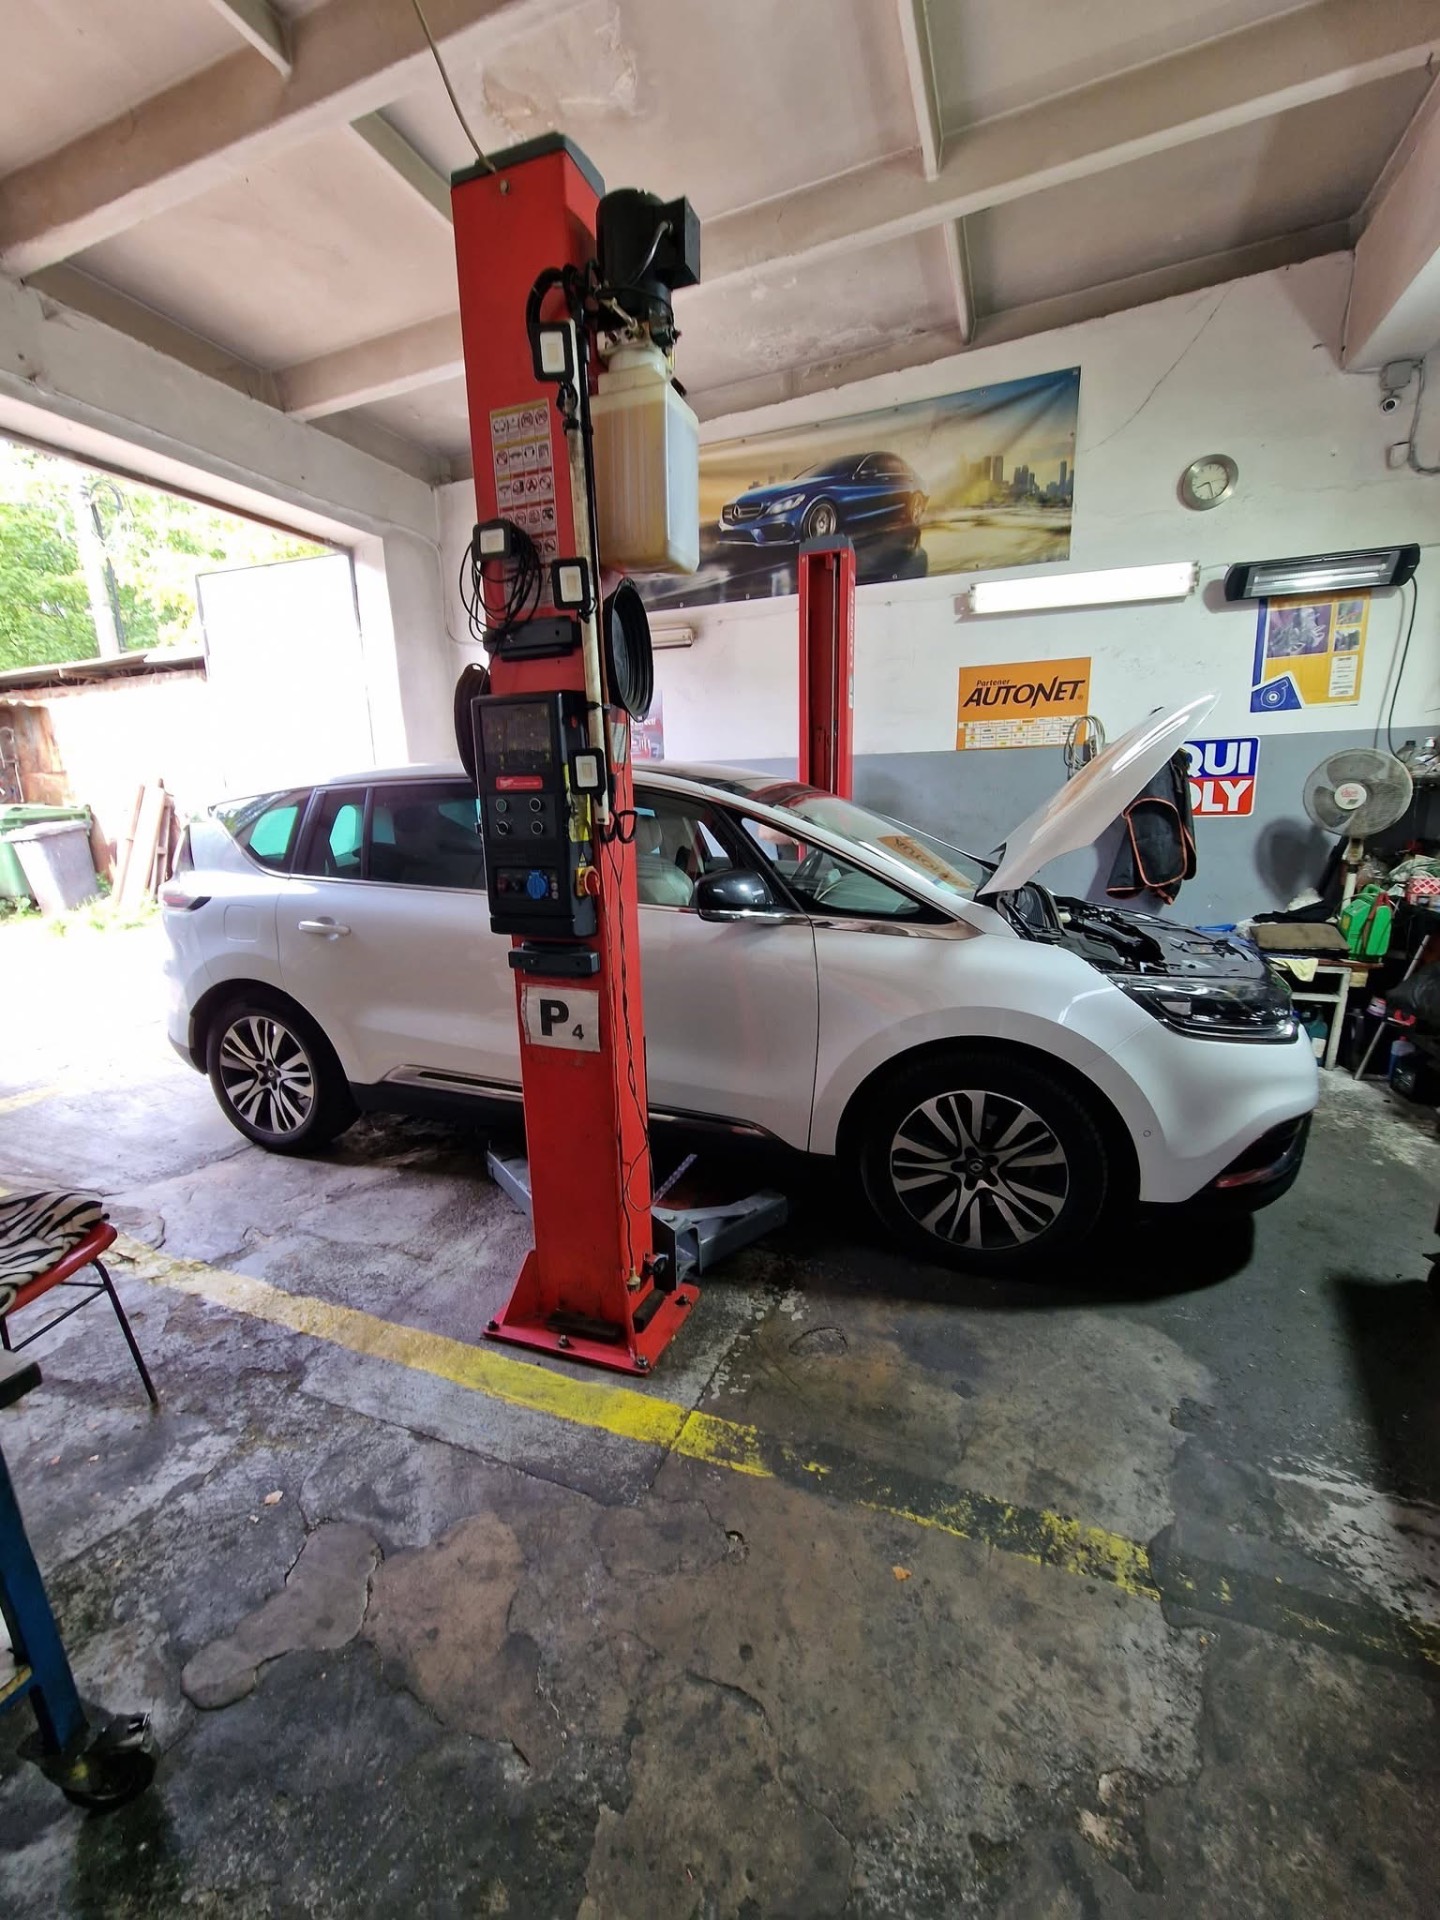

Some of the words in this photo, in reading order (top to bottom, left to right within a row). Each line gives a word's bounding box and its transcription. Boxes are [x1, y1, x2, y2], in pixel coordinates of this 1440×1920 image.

[976, 679, 1011, 687] Partener
[540, 999, 569, 1036] P
[572, 1024, 584, 1040] 4
